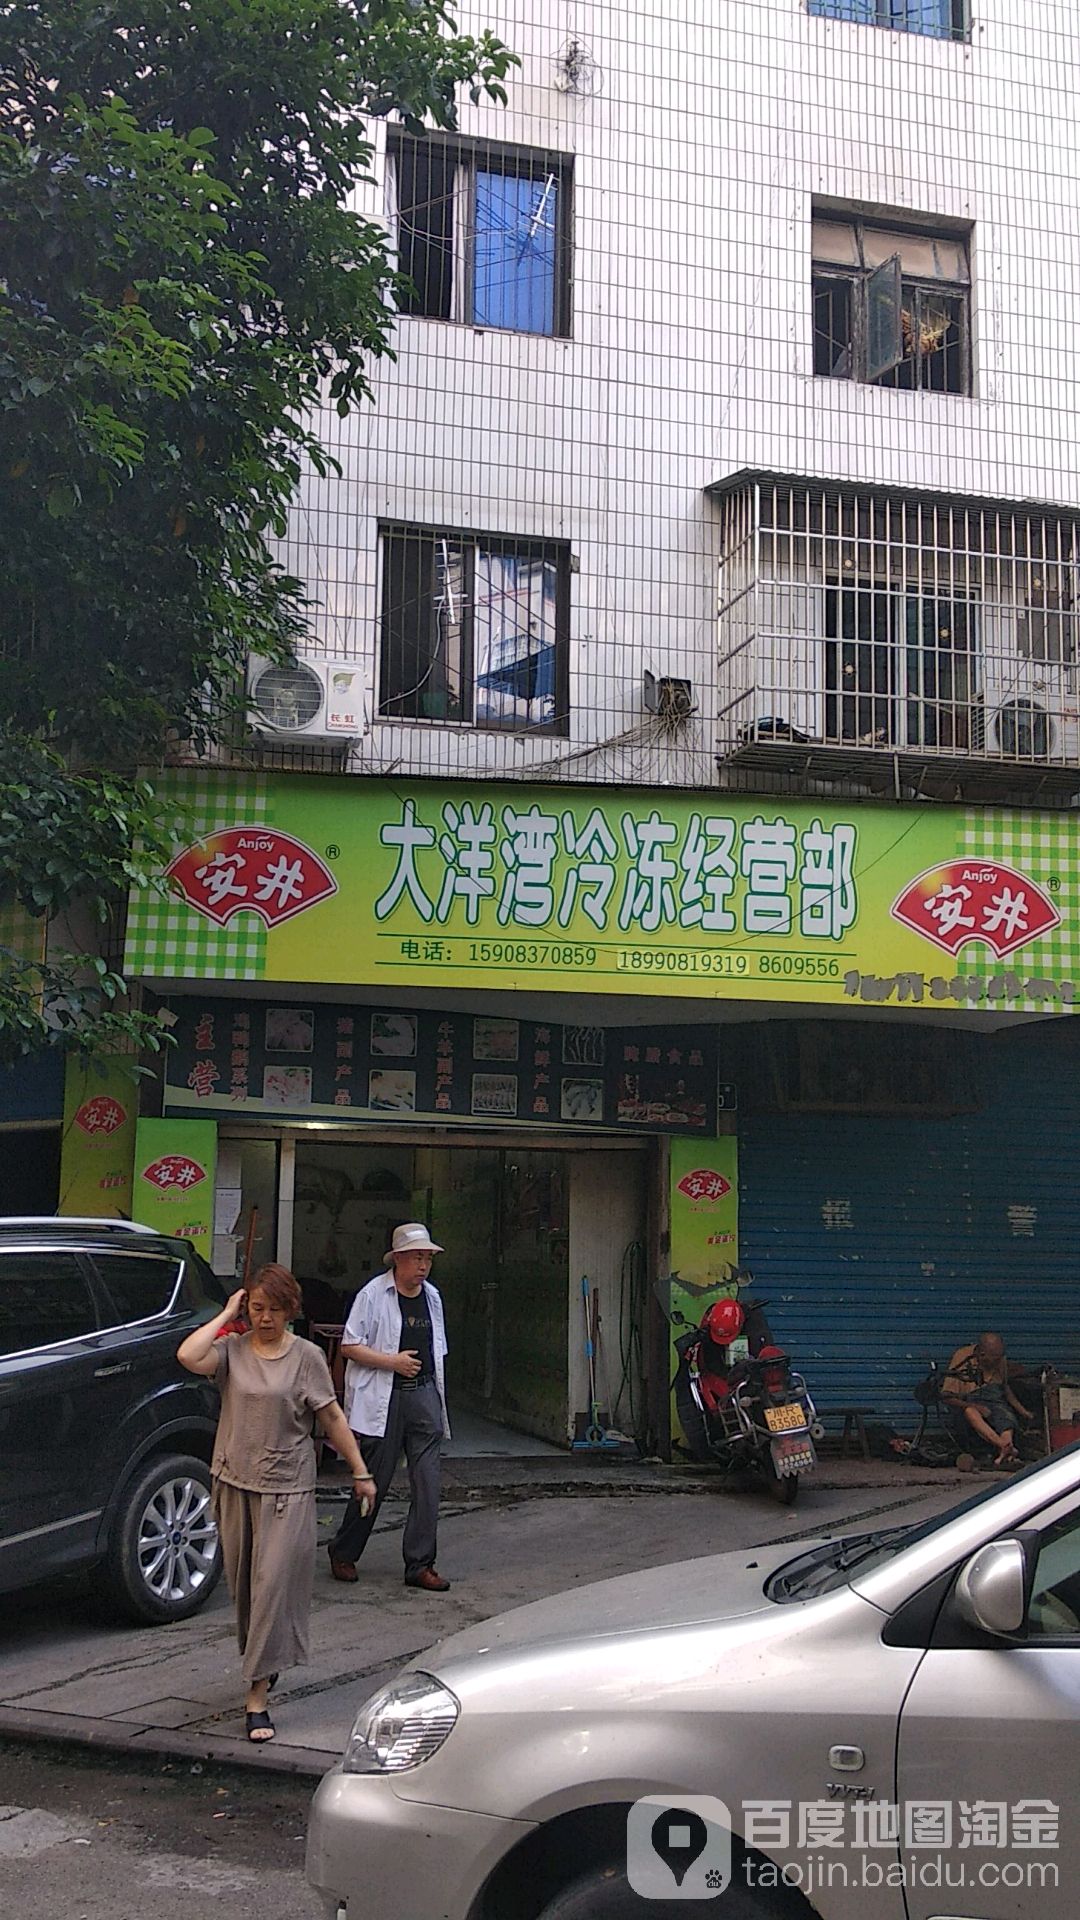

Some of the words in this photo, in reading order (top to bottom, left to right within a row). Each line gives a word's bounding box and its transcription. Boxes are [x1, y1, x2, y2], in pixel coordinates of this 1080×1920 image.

[237, 835, 274, 852] Anjoy
[194, 852, 305, 909] 安井
[374, 798, 858, 942] 大洋湾冷冻经营部
[962, 867, 998, 884] Anjoy
[923, 884, 1029, 940] 安井
[469, 943, 597, 967] 15908370859
[619, 951, 748, 974] 18990819319
[759, 956, 840, 977] 8609556
[84, 1107, 119, 1130] 安井
[154, 1165, 196, 1186] 安井
[686, 1177, 723, 1197] 安井
